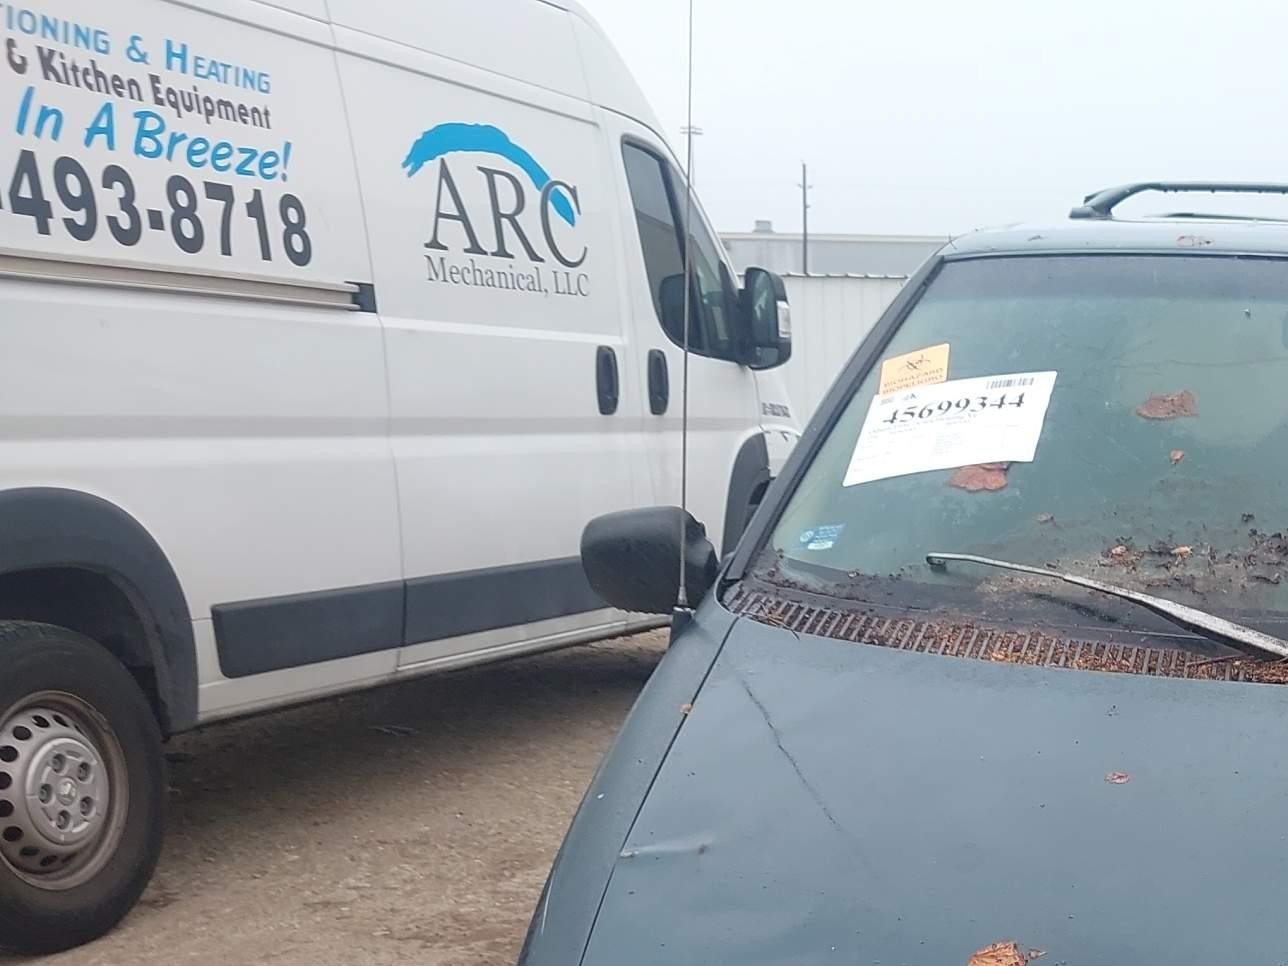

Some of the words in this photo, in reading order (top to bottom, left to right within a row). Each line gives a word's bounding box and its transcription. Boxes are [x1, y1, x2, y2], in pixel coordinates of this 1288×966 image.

[0, 3, 111, 55] IONING
[126, 35, 150, 65] &
[165, 39, 271, 94] HEATING
[6, 37, 27, 75] &
[35, 45, 144, 102] Kitchen
[148, 73, 272, 129] Equipment
[16, 86, 63, 141] In
[84, 102, 115, 151] A
[133, 110, 292, 182] Breeze!
[0, 149, 312, 267] 493-8718
[424, 157, 588, 268] ARC
[424, 255, 549, 298] Mechanical,
[552, 270, 590, 297] LLC
[882, 392, 1026, 424] 45699344
